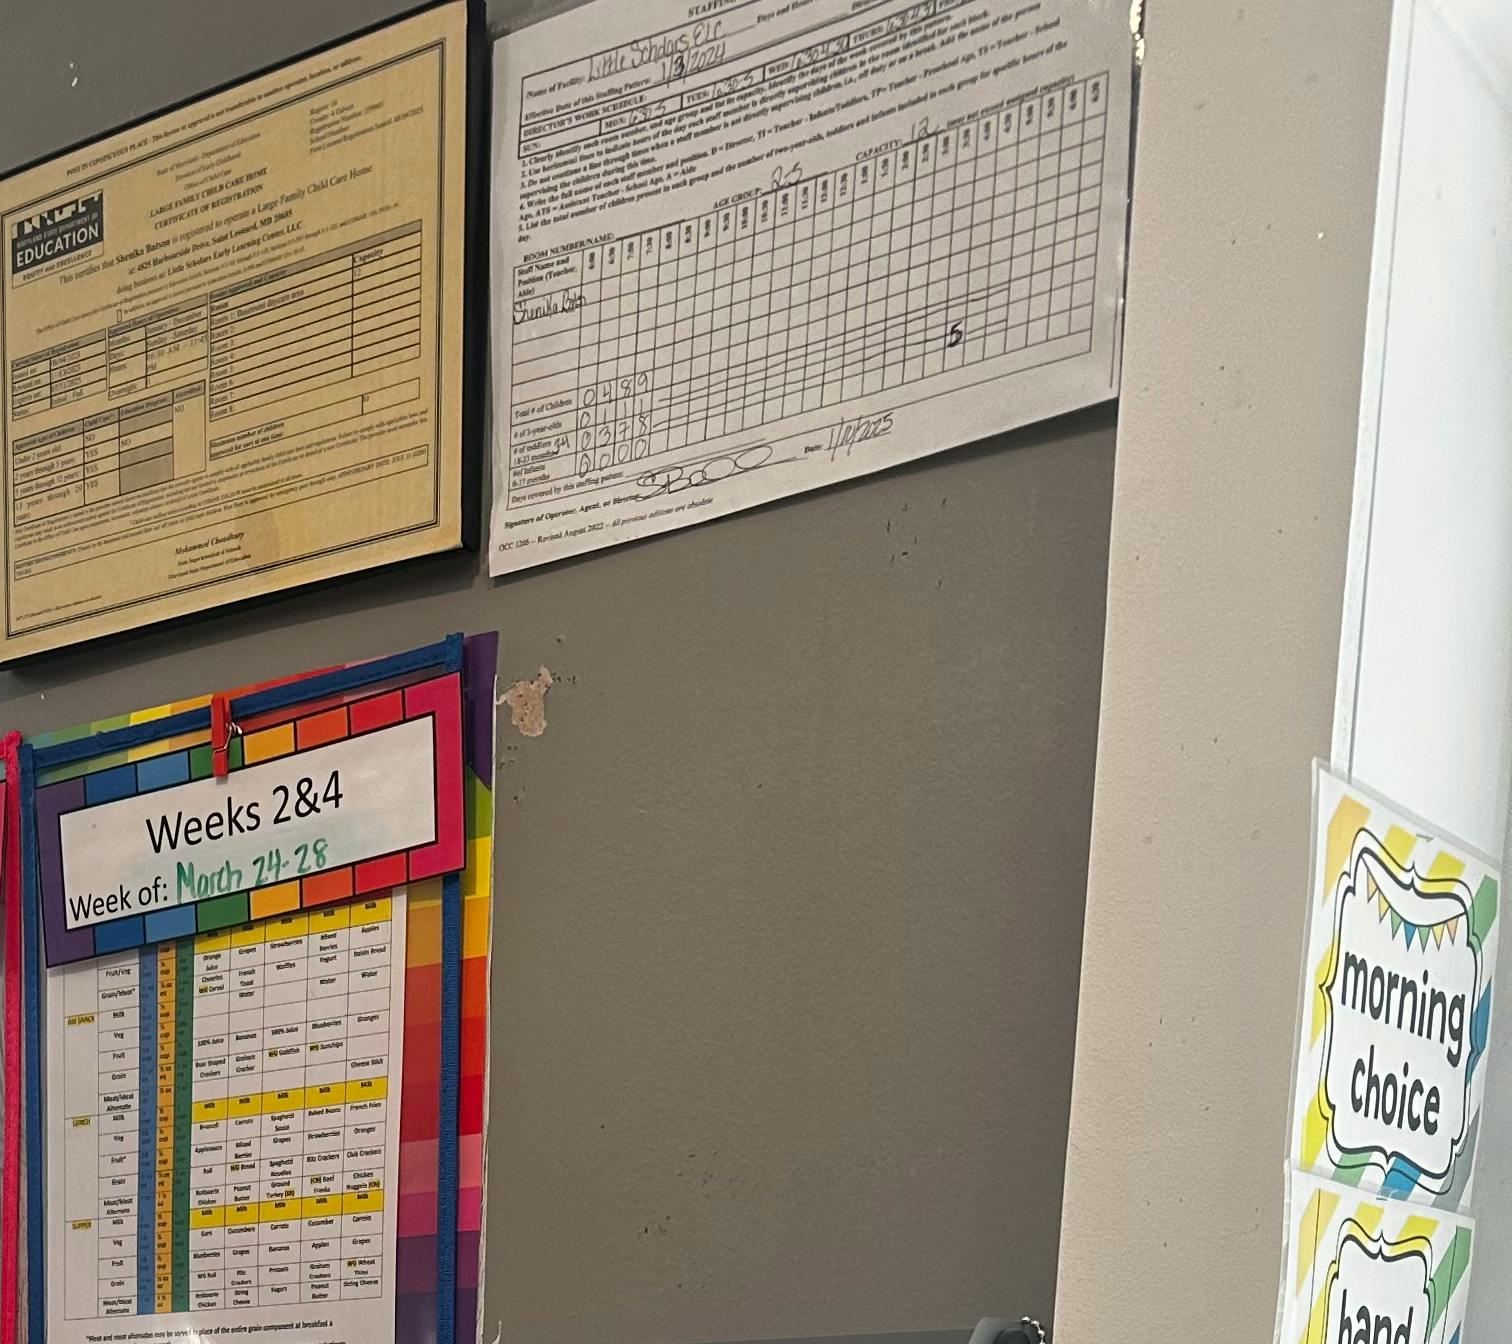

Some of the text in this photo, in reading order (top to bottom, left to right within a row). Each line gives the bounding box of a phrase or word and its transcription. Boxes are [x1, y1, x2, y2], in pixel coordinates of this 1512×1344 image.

[16, 221, 100, 268] EDUCATION
[145, 769, 344, 854] Weeks 2&4
[69, 838, 329, 922] Week of: March 24-28
[1341, 950, 1466, 1068] morning
[1351, 1044, 1442, 1137] choice
